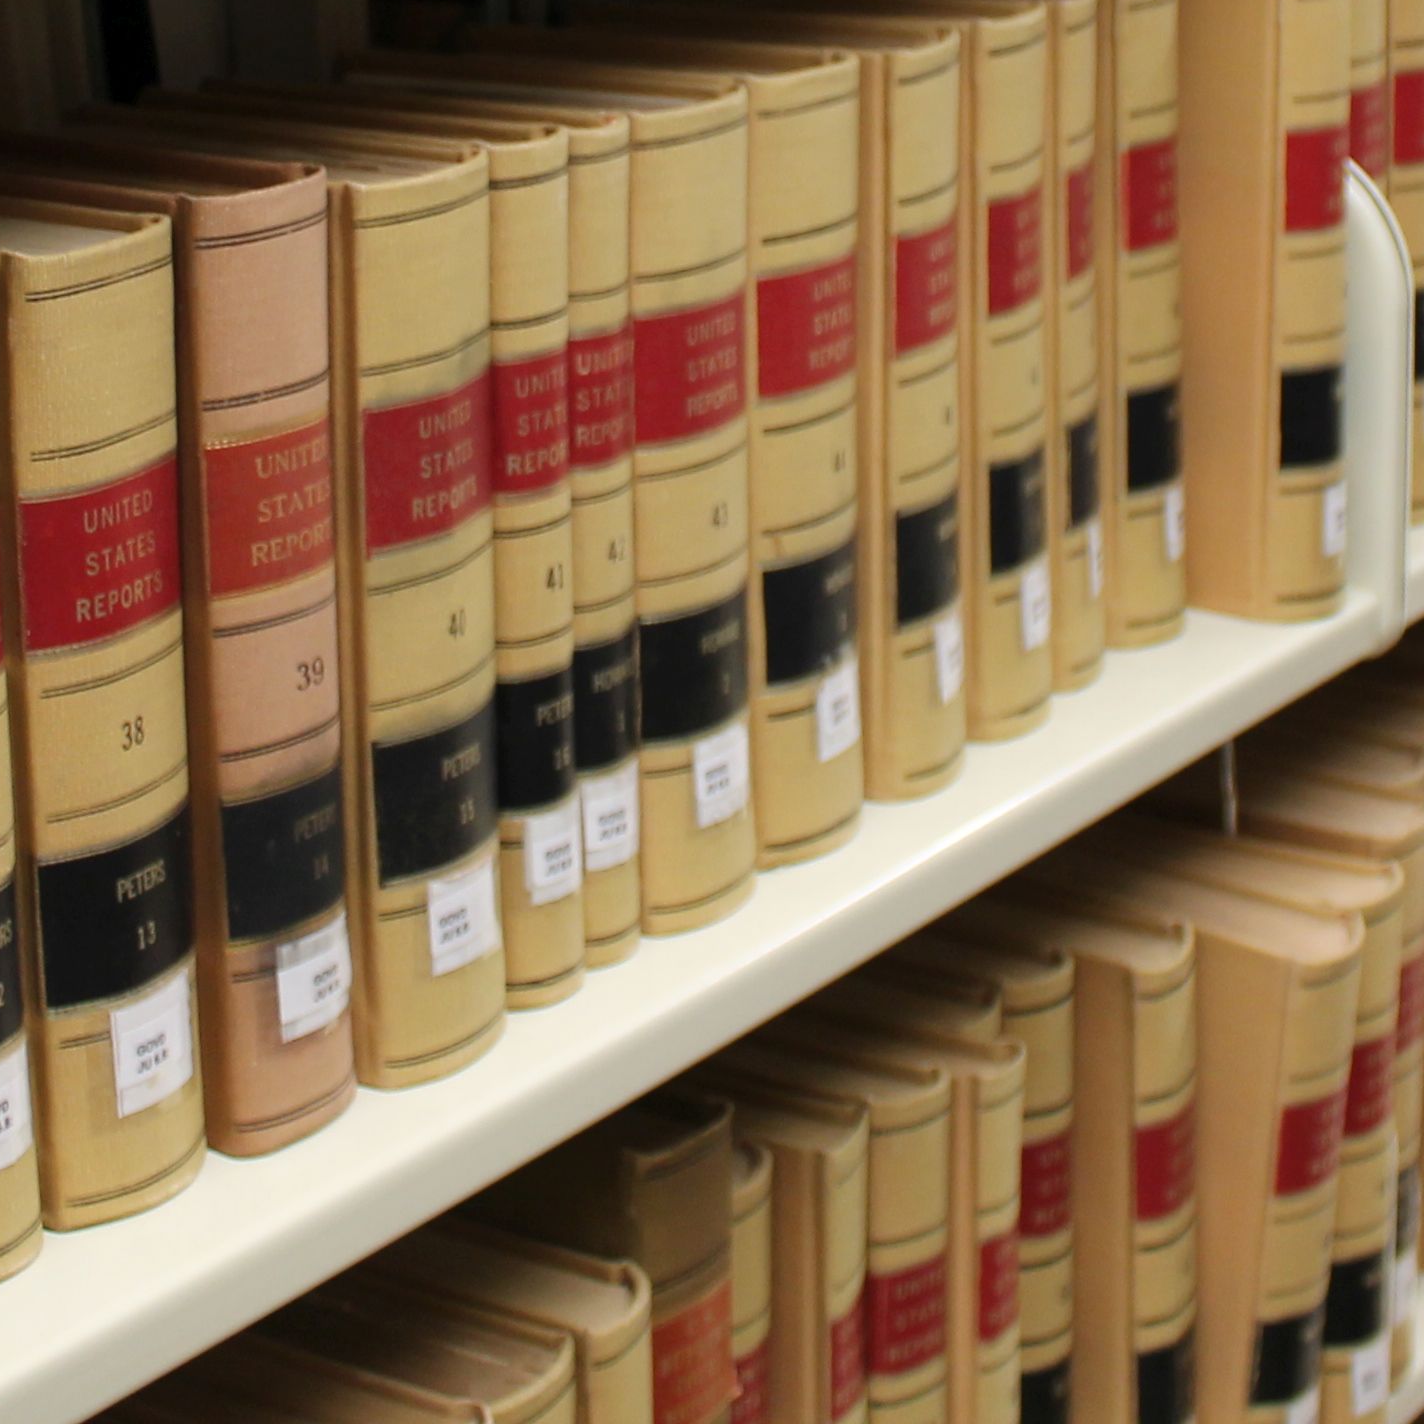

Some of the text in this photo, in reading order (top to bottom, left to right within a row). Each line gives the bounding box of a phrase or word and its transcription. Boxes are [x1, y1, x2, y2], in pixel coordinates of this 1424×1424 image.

[419, 400, 472, 439] UNITED
[420, 438, 474, 479] STATES
[83, 488, 153, 535] UNITED
[412, 477, 476, 522] REPORTS
[85, 530, 157, 578] STATES
[75, 573, 164, 624] REPORTS
[296, 656, 325, 691] 39
[121, 717, 145, 752] 38
[116, 859, 166, 904] PETERS
[137, 921, 157, 951] 13
[136, 1032, 167, 1058] GOVD
